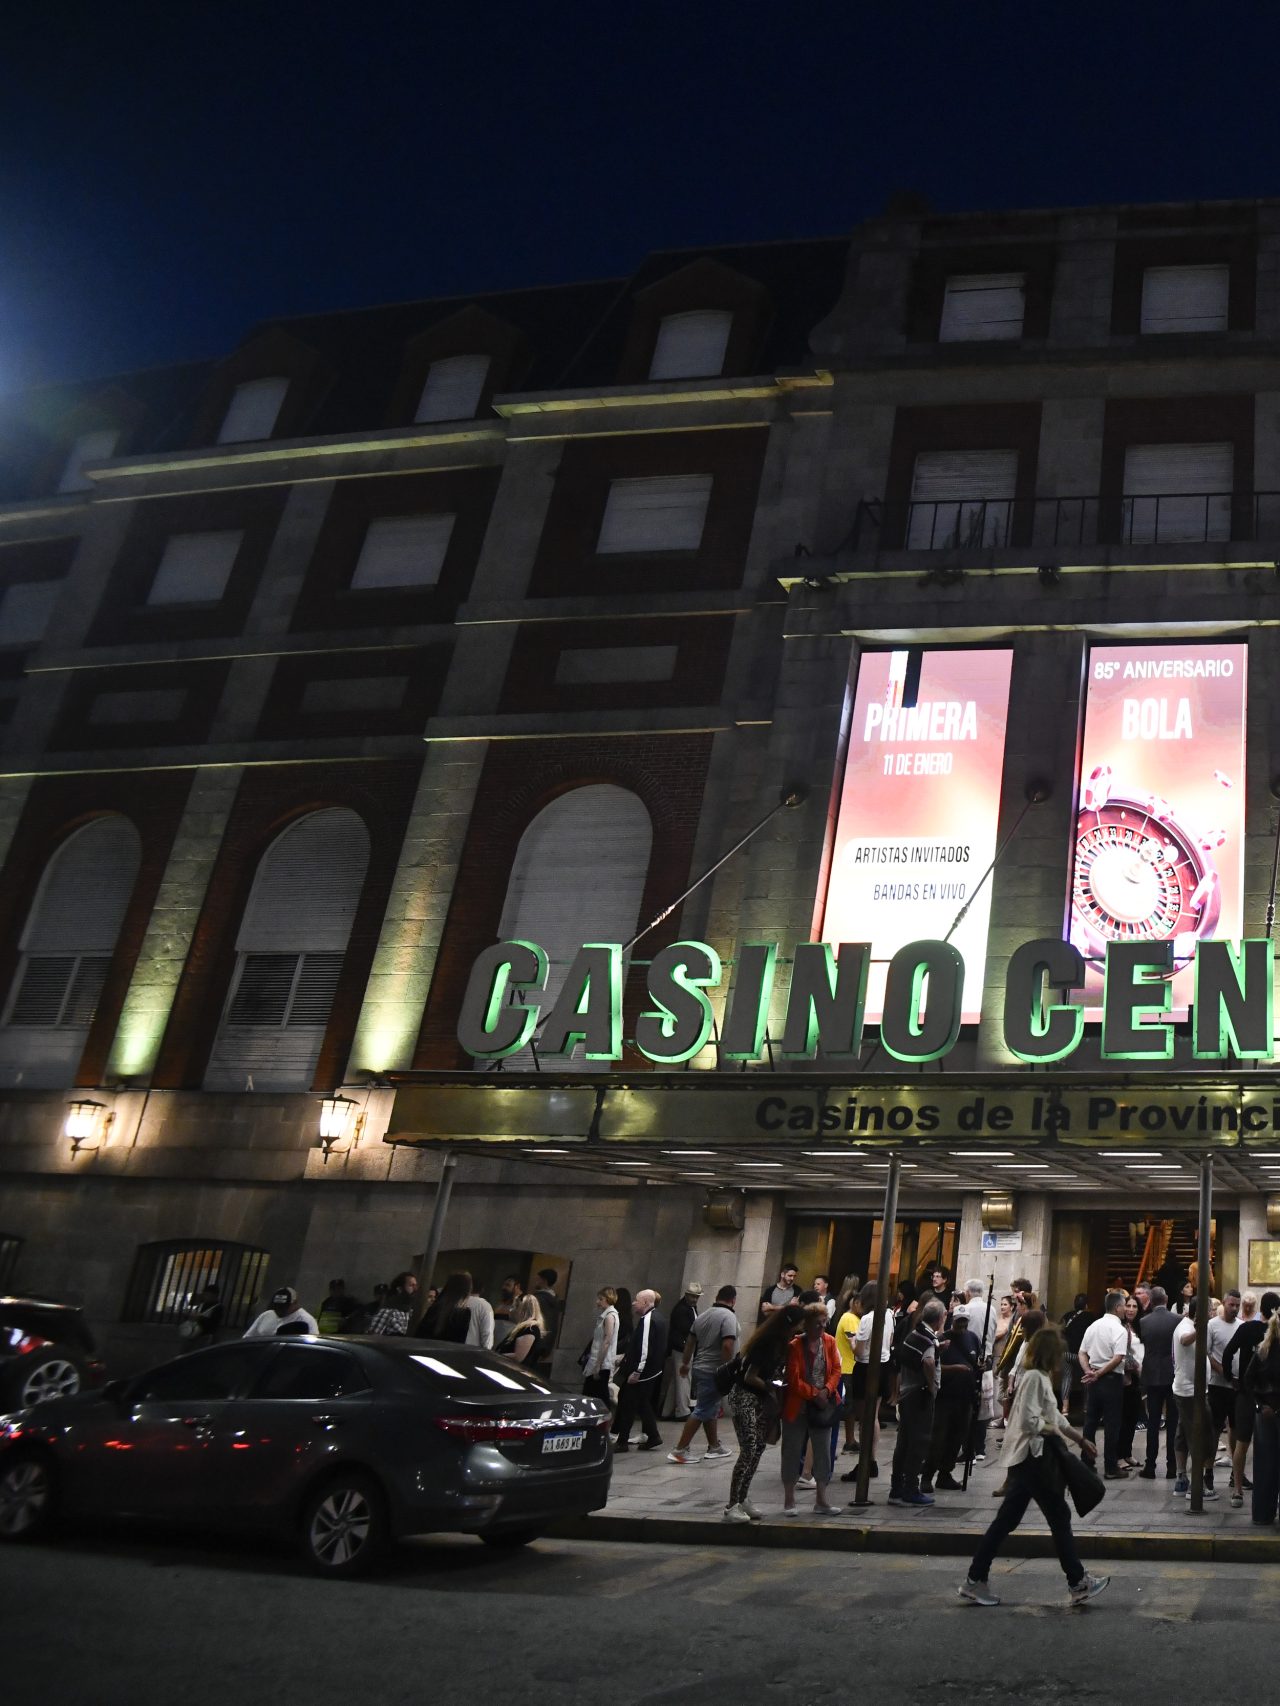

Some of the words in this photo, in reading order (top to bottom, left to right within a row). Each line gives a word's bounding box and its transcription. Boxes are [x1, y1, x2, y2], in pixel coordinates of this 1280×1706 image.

[1123, 659, 1234, 679] ANIVERSARIO
[863, 701, 977, 742] PRIMERA
[1121, 698, 1193, 740] BOLA
[883, 753, 894, 775] 11
[895, 753, 913, 775] DE
[913, 751, 953, 775] ENERO
[855, 846, 909, 863] ARTISTAS
[910, 845, 970, 863] INVITADOS
[873, 883, 920, 901] BANDAS
[923, 883, 937, 900] EN
[940, 883, 966, 900] VIVO
[457, 938, 965, 1064] CASINO
[755, 1096, 940, 1131] Casinos
[957, 1097, 1014, 1131] de
[1031, 1097, 1070, 1131] la
